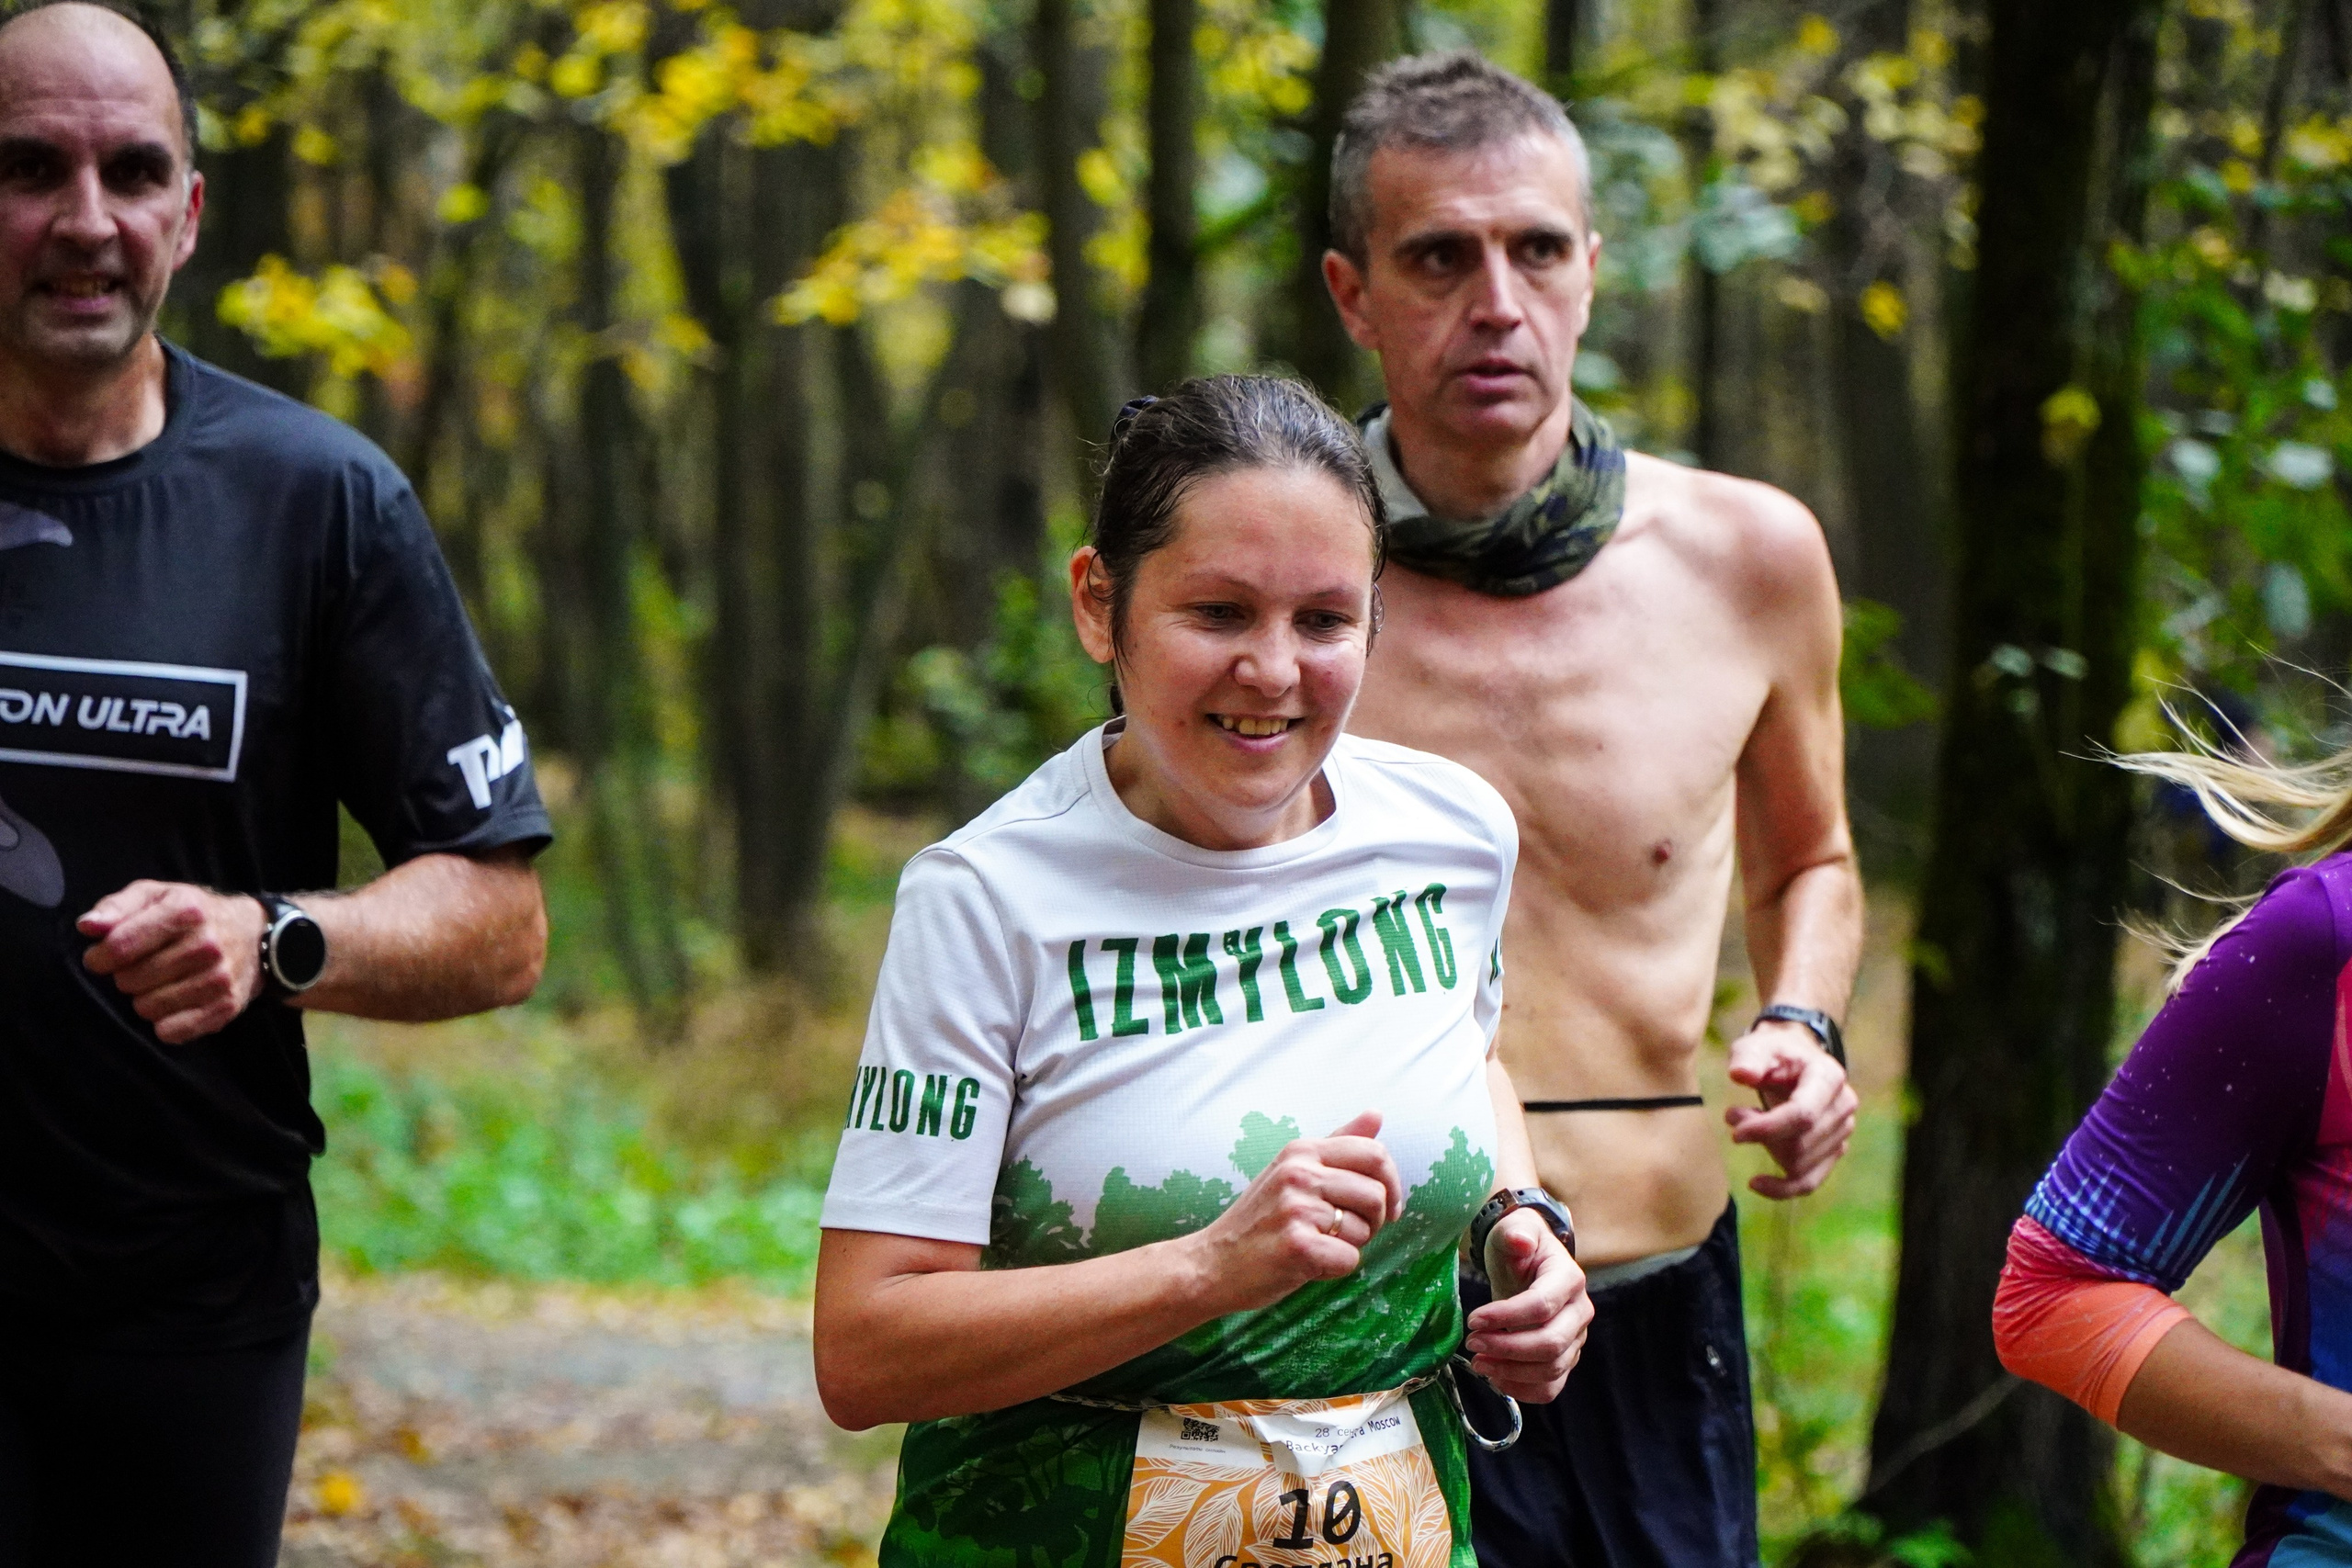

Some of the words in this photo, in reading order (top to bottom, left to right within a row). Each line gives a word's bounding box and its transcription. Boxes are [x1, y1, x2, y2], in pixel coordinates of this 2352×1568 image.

[77, 695, 210, 741] ULTRA
[1068, 883, 1458, 1042] IZMYLONG
[1315, 1427, 1330, 1438] 28
[1367, 1416, 1401, 1433] Moscow
[1272, 1480, 1362, 1550] 10
